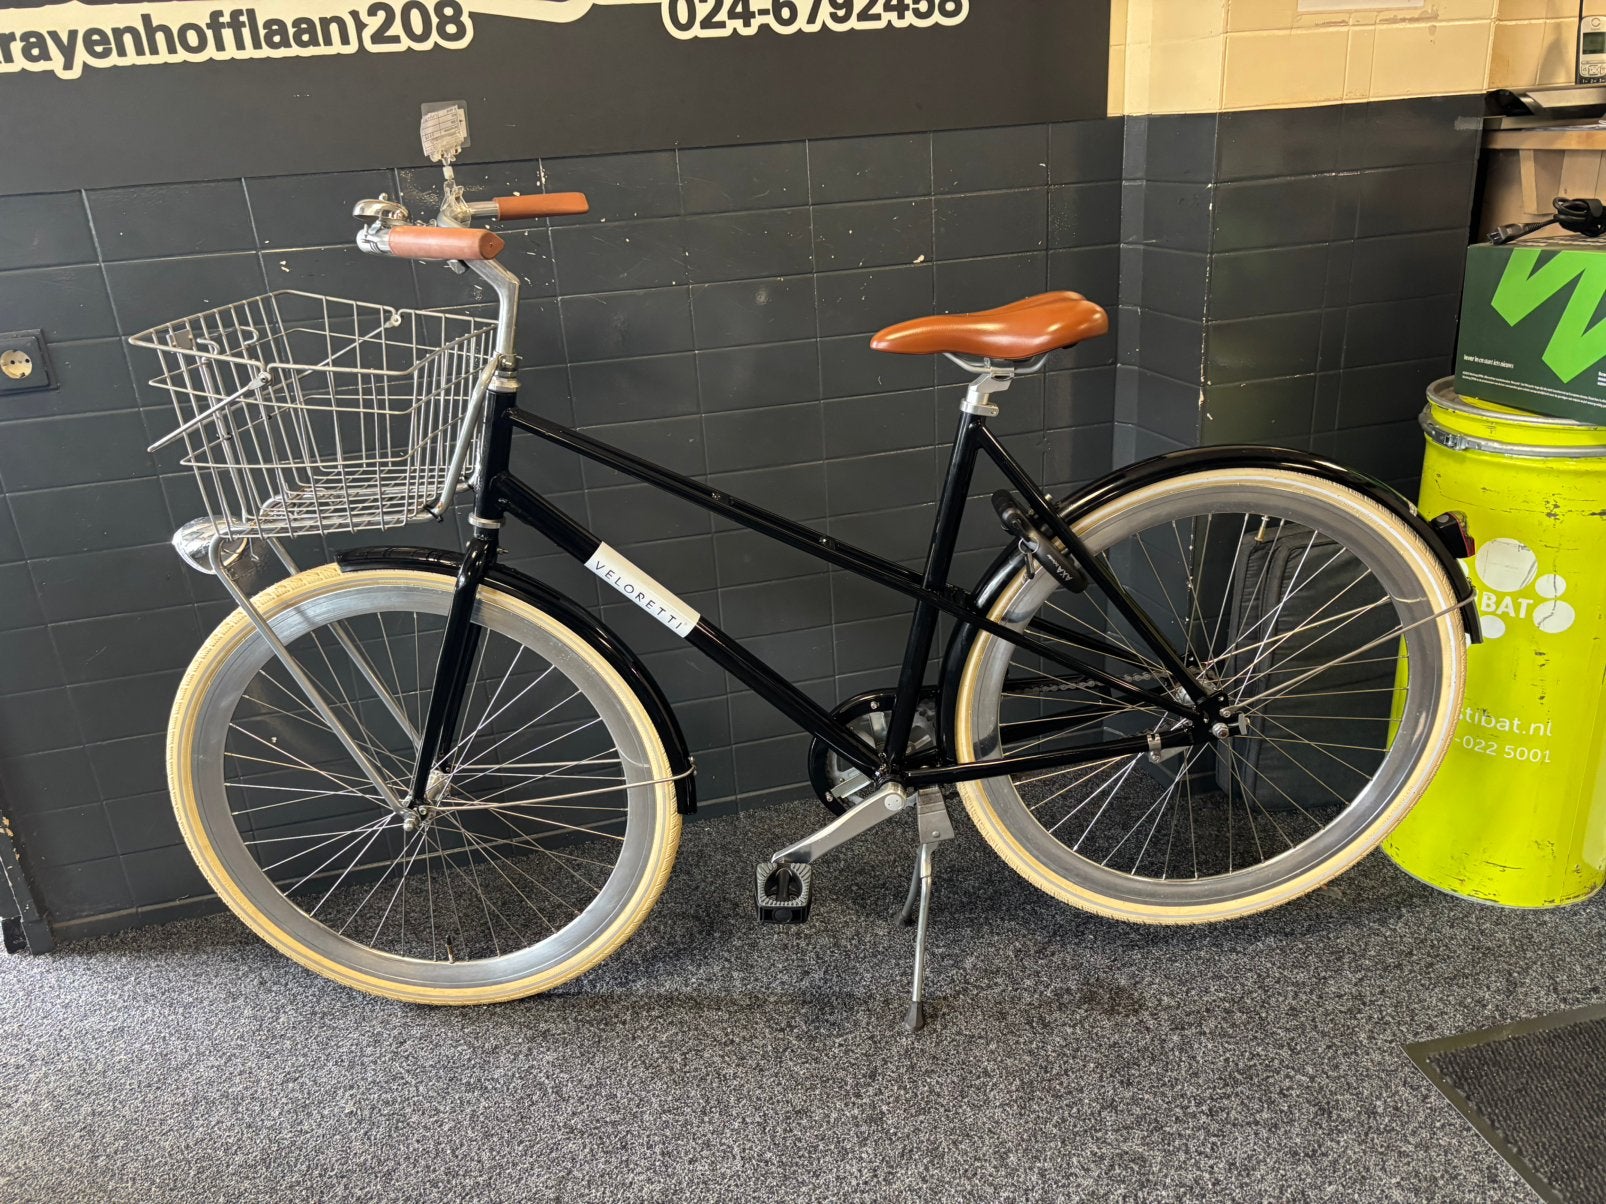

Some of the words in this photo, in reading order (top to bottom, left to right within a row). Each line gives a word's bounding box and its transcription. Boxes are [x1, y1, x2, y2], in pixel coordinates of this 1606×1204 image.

[0, 8, 351, 71] rayenhofflaan
[367, 0, 466, 45] 208
[594, 560, 683, 630] VELORETTI
[1475, 589, 1534, 619] BAT
[1503, 745, 1551, 763] 5001
